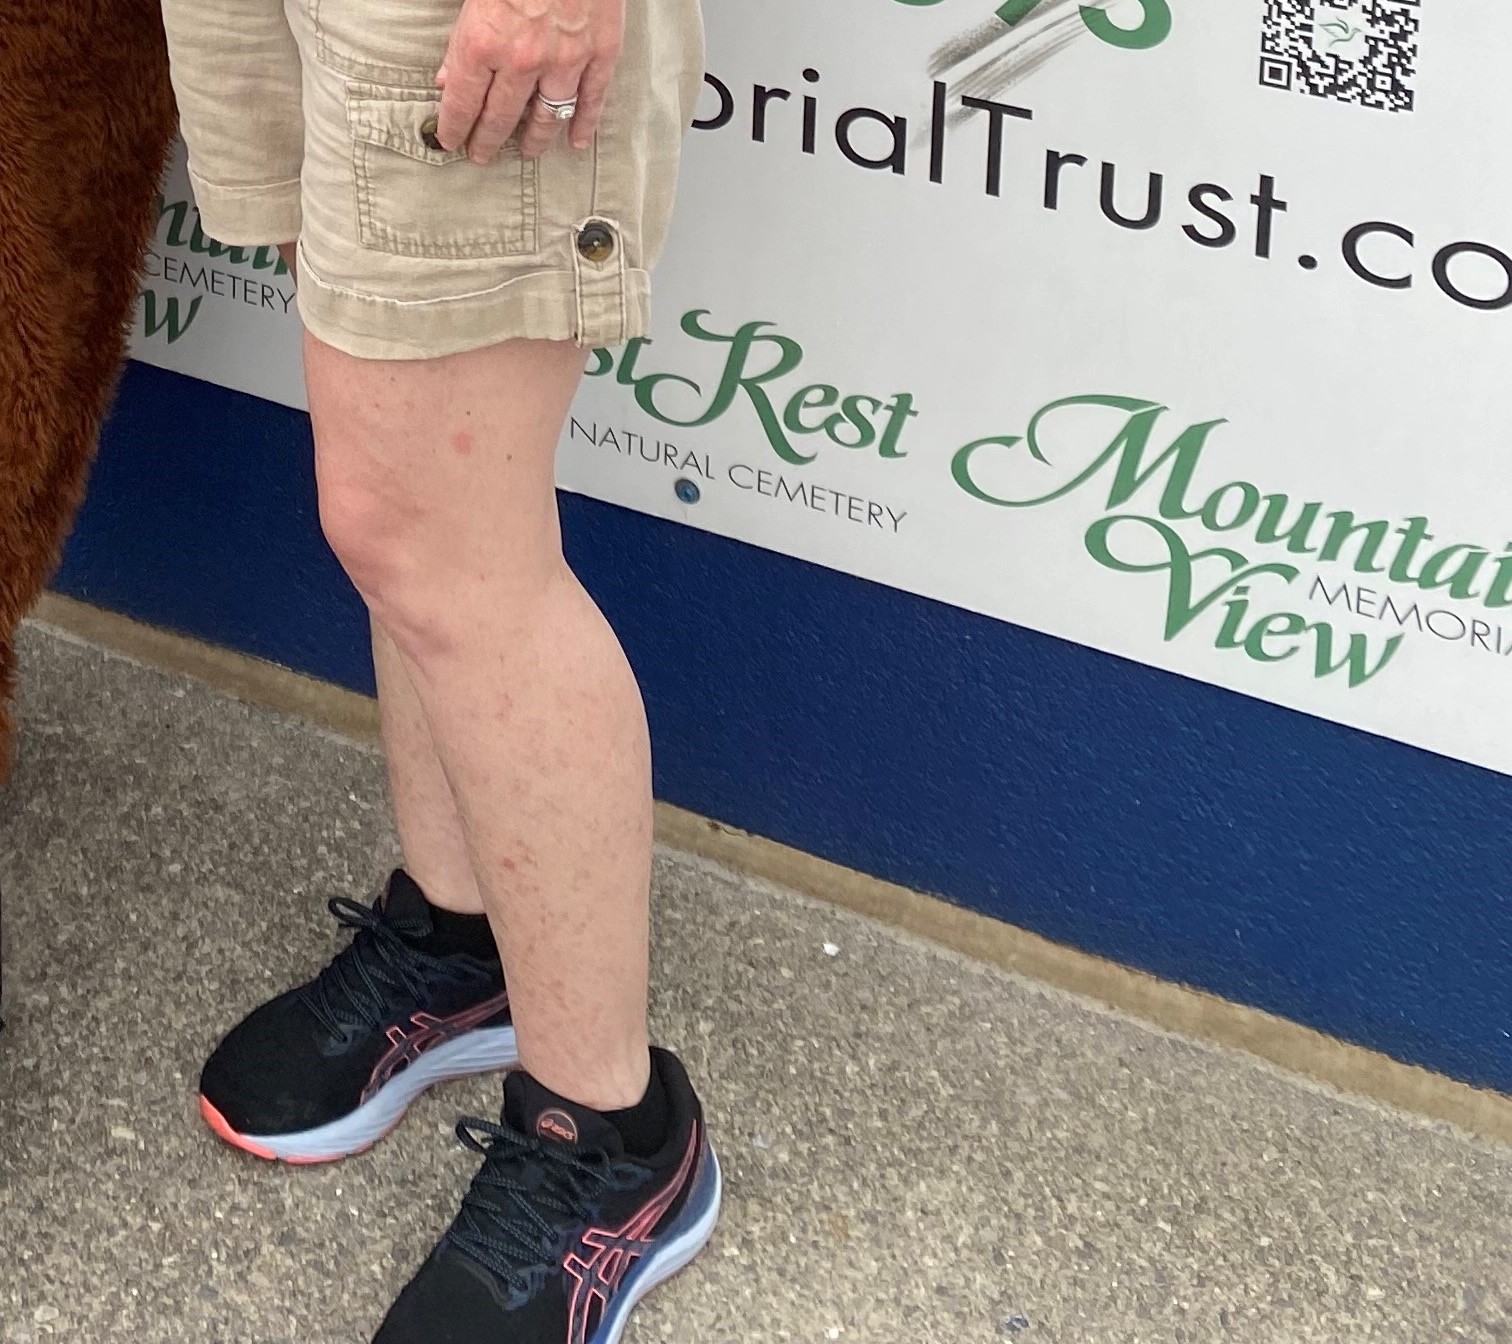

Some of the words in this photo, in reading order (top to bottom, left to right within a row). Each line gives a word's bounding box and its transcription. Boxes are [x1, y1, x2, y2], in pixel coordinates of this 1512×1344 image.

[144, 252, 296, 314] CEMETERY
[634, 309, 919, 466] Rest
[570, 416, 716, 480] NATURAL
[728, 464, 908, 533] CEMETERY
[950, 394, 1512, 608] Mountai
[1084, 515, 1406, 689] View
[1308, 575, 1512, 656] MEMORI
